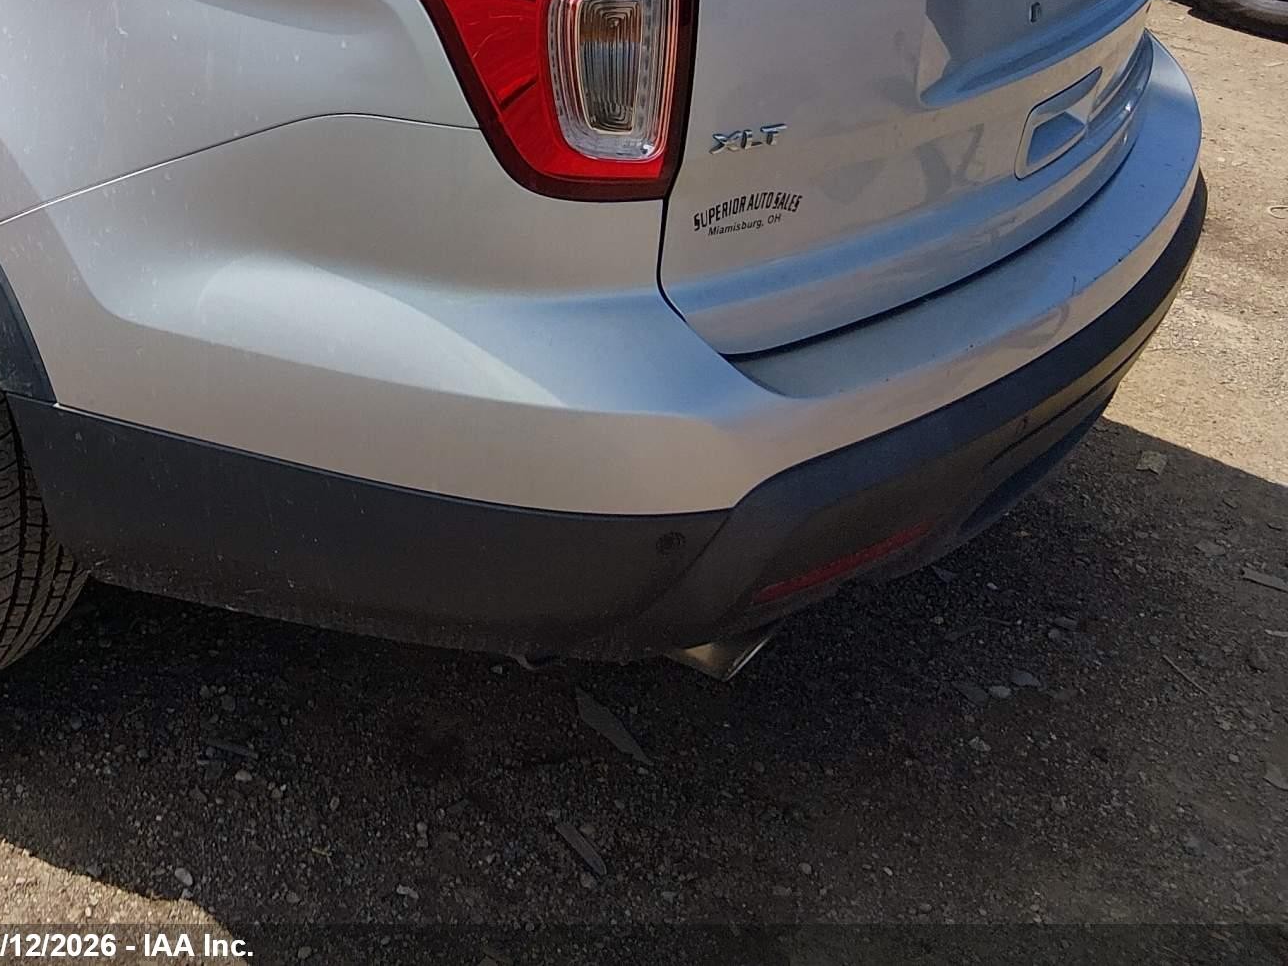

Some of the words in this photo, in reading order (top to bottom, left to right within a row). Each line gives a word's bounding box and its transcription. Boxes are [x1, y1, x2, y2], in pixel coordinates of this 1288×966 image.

[709, 123, 788, 154] XLT
[693, 196, 747, 231] SUPERIOR
[746, 192, 774, 211] AUTO
[772, 192, 803, 212] SALES
[767, 214, 781, 224] OH
